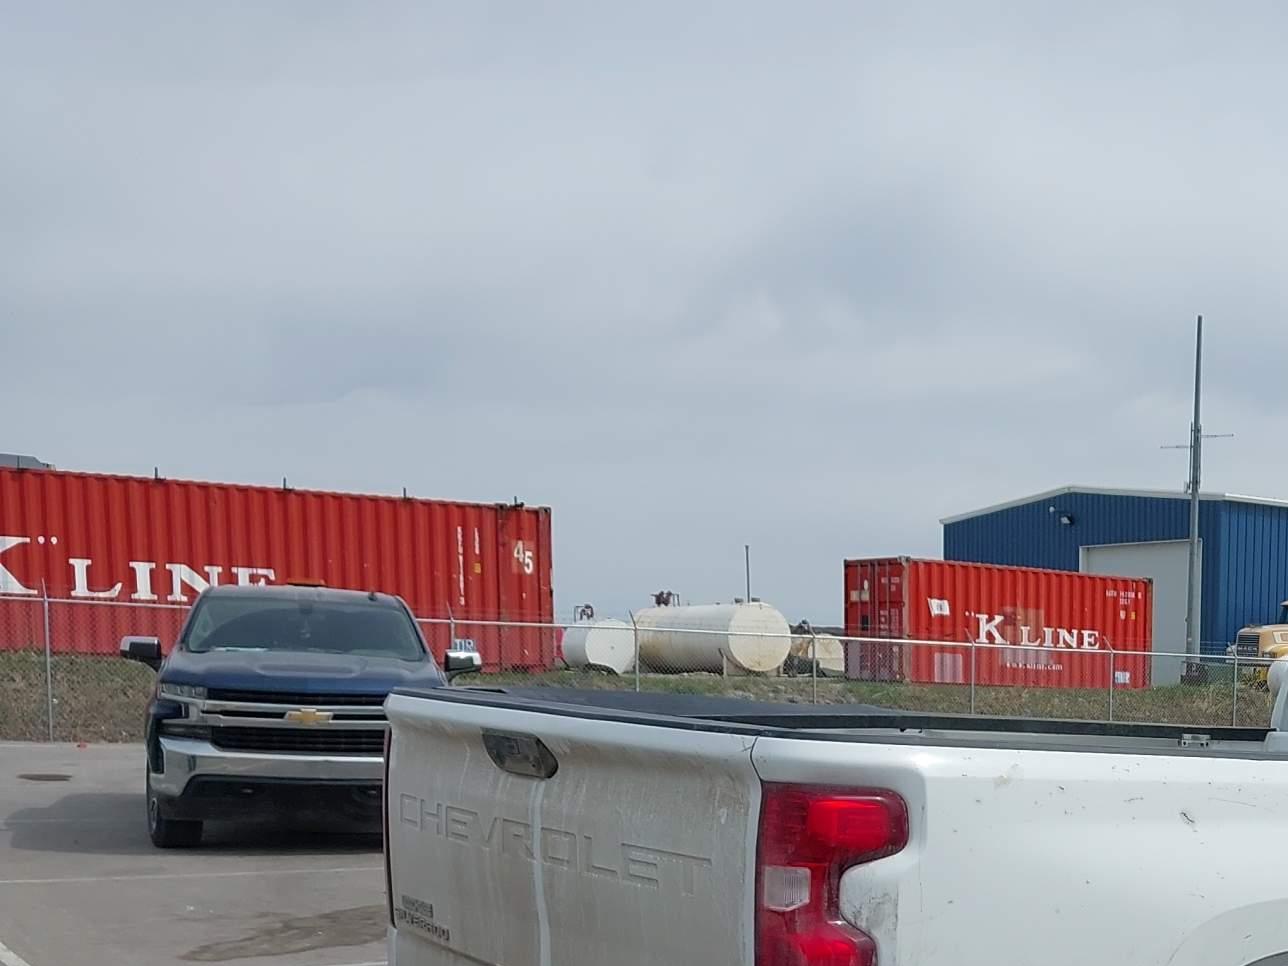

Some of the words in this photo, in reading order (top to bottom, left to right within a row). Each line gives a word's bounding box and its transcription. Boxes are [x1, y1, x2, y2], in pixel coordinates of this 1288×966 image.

[513, 540, 534, 575] 45
[1020, 626, 1100, 650] LINE
[400, 793, 712, 897] CHEVROLET
